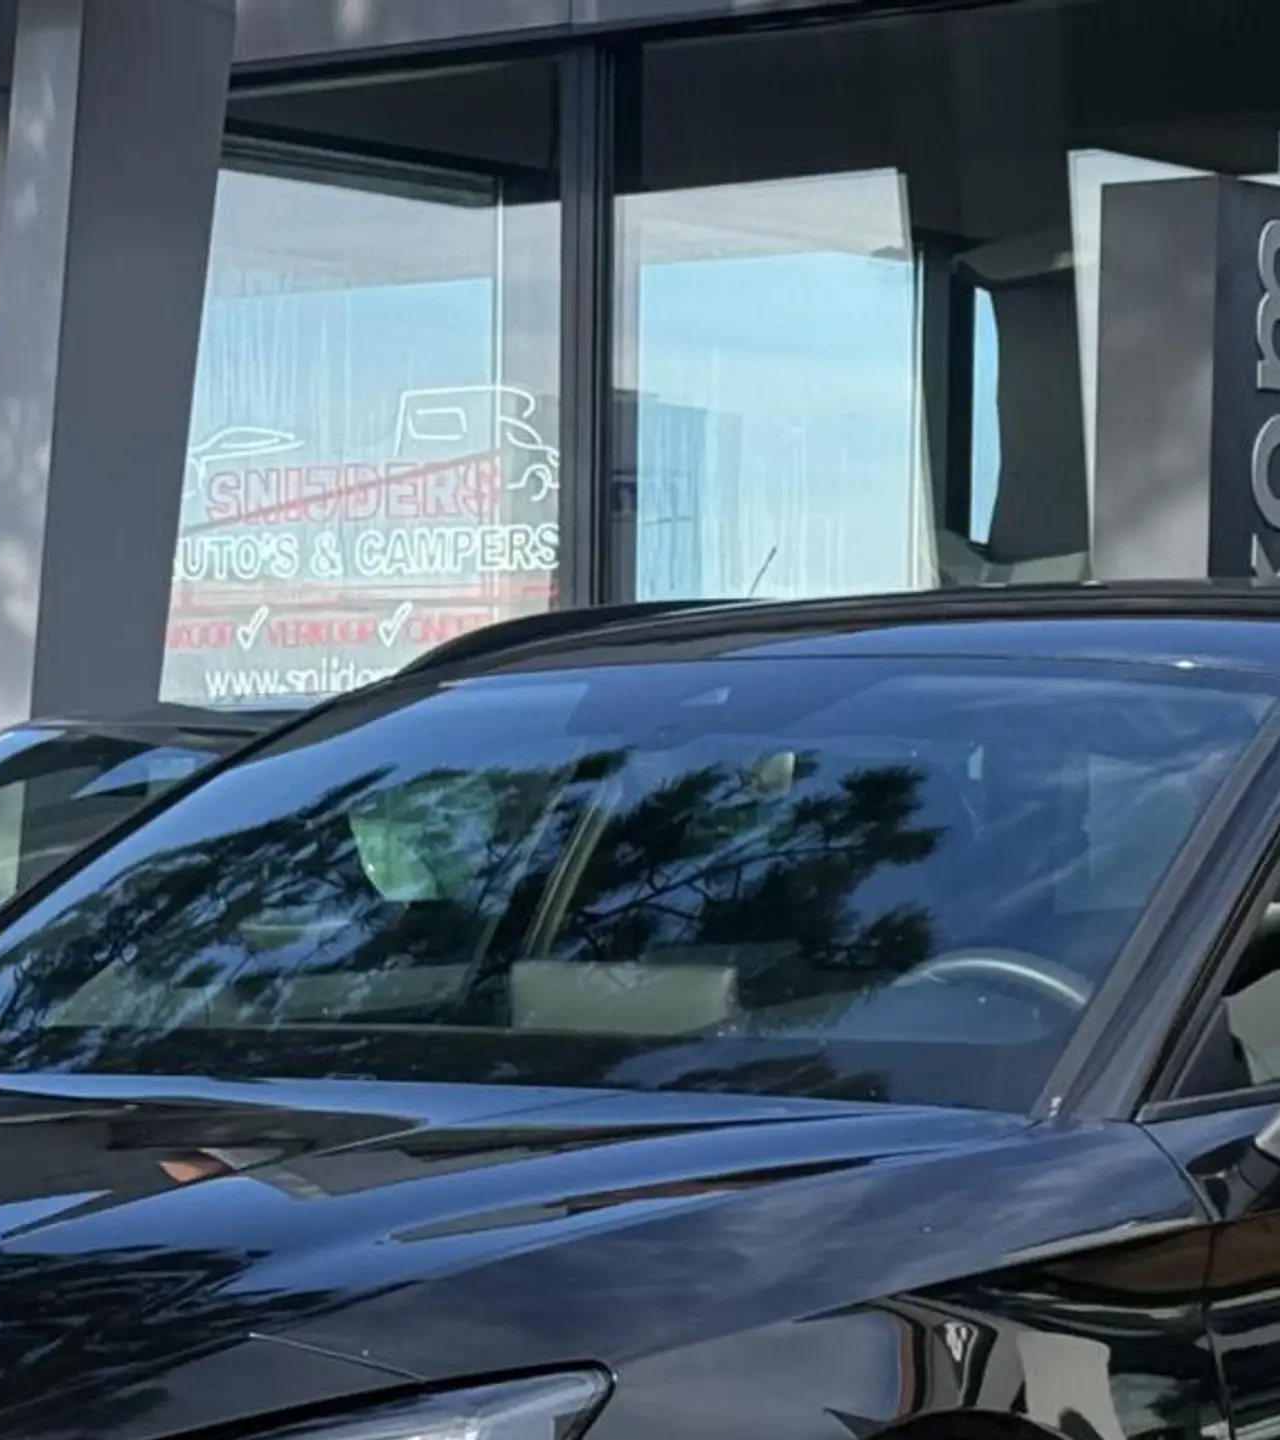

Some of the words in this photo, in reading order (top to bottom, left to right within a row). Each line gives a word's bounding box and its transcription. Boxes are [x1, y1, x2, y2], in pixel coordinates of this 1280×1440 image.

[206, 461, 498, 525] SNIJDERS
[173, 532, 299, 582] UTO'S
[310, 530, 343, 578] &
[356, 522, 559, 577] CAMPERS
